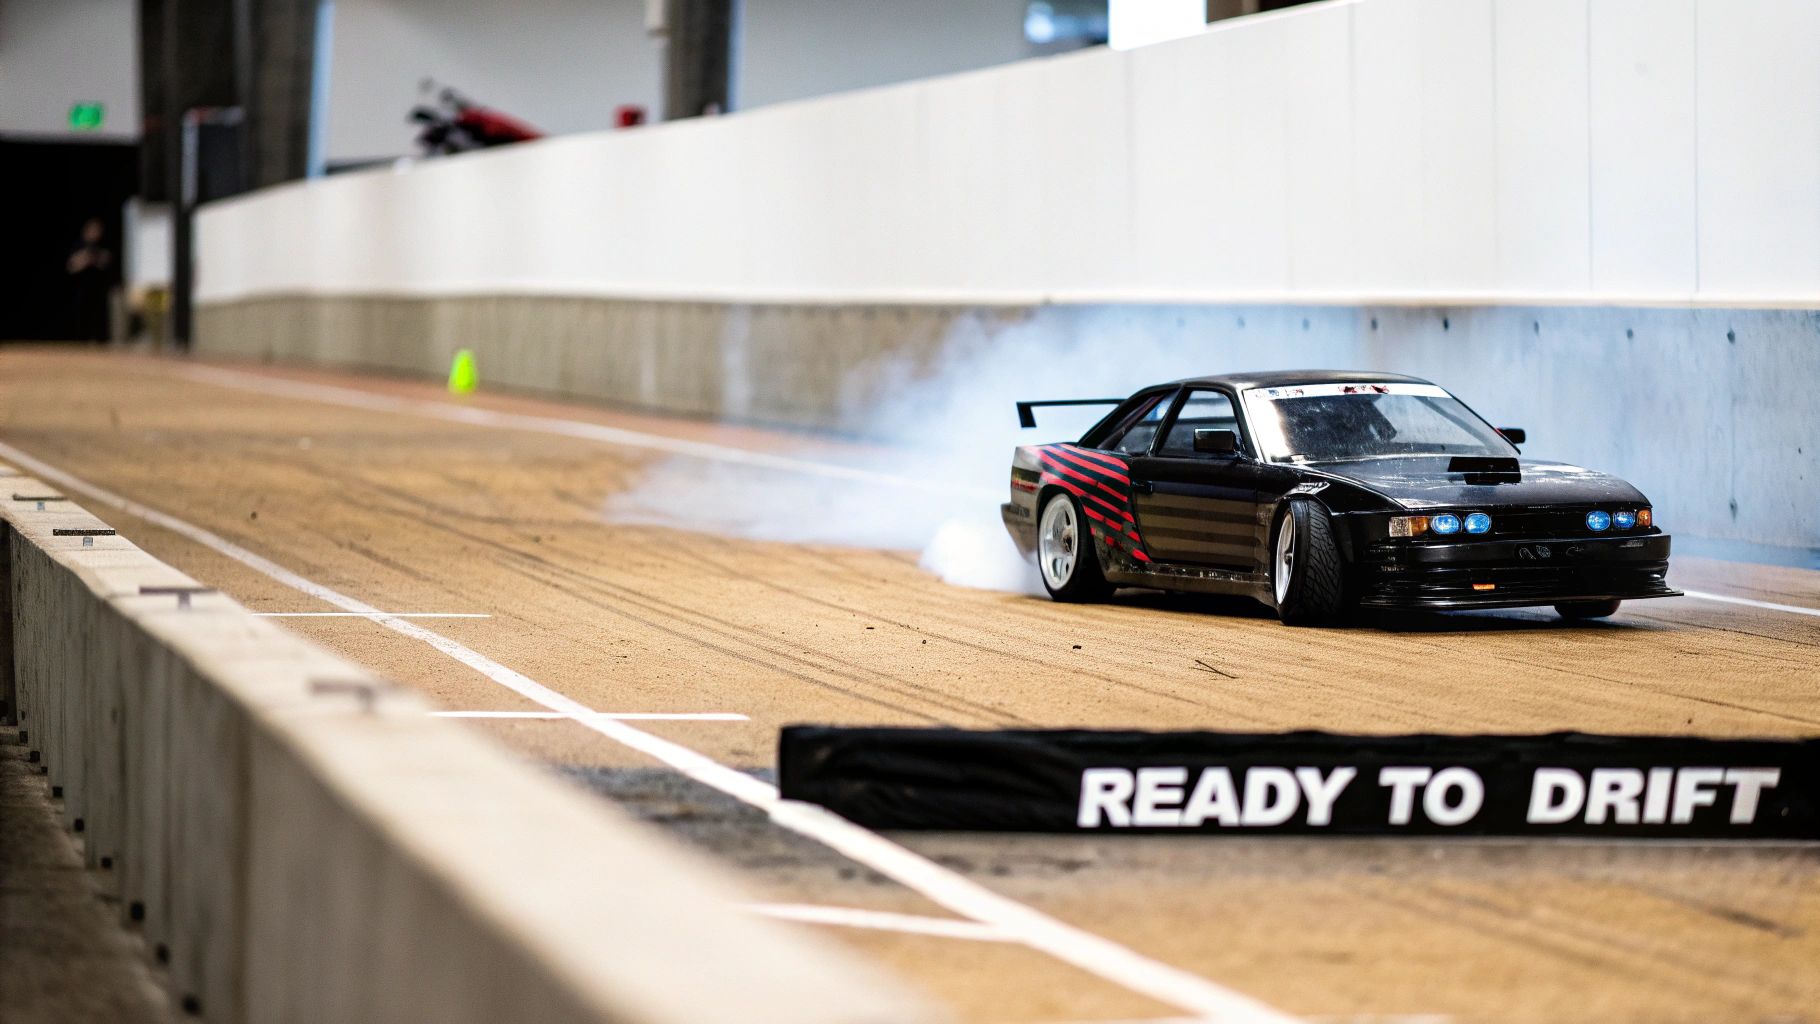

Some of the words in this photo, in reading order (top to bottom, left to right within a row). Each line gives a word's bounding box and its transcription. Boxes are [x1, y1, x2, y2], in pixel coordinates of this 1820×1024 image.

[1077, 767, 1357, 828] READY
[1378, 767, 1484, 825] TO
[1526, 767, 1781, 824] DRIFT
